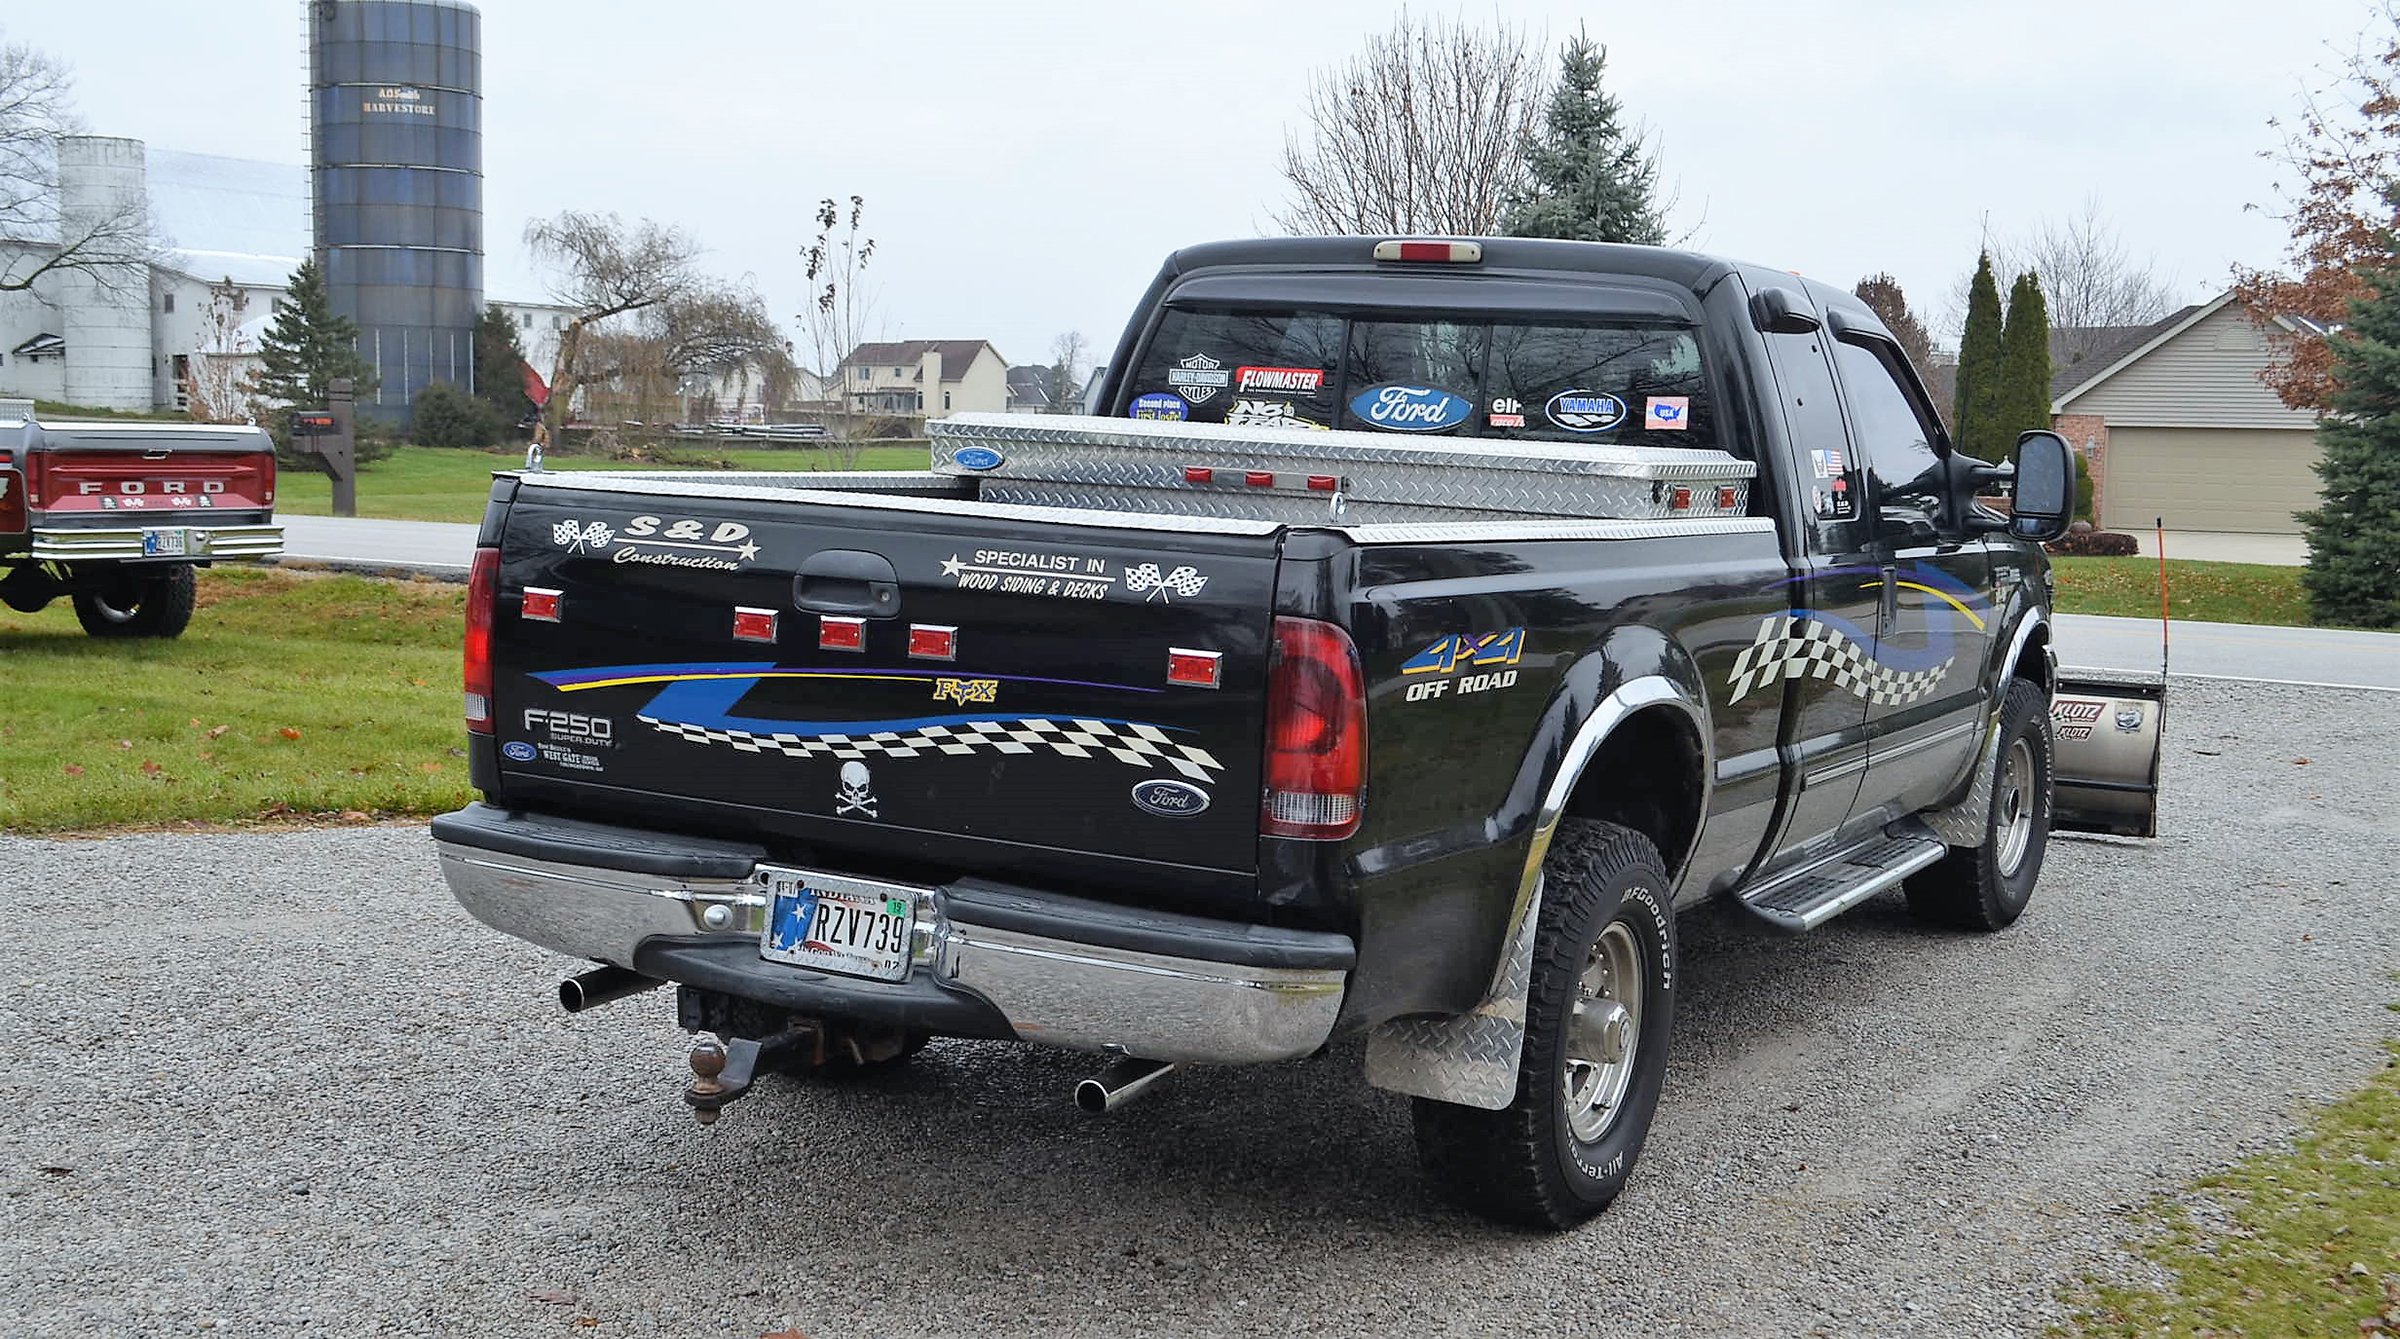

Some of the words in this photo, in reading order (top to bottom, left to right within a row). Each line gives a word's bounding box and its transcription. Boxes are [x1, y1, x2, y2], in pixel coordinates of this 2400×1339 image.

[363, 102, 435, 115] HARVESTORE
[1185, 358, 1215, 370] MOTOR
[1239, 369, 1318, 392] FLOWMASTER
[1183, 386, 1212, 400] CYCLES
[1371, 385, 1449, 423] Ford
[1560, 397, 1614, 414] YAMAHA
[1659, 409, 1674, 418] USA
[80, 481, 224, 495] FORD
[613, 546, 739, 571] Construction
[974, 550, 1079, 571] SPECIALIST
[1086, 558, 1106, 573] IN
[957, 571, 998, 589] WOOD
[1000, 575, 1044, 595] SIDING
[1049, 583, 1059, 596] &
[1063, 582, 1108, 600] DECKS
[933, 678, 998, 706] FOX
[1406, 679, 1450, 702] OFF
[1457, 669, 1518, 695] ROAD
[2052, 703, 2101, 718] KLOTZ
[550, 733, 582, 744] SUPER
[585, 737, 613, 747] DUTY
[2059, 726, 2091, 738] KLOTZ
[1149, 787, 1189, 809] Ford
[814, 903, 904, 954] RZV739
